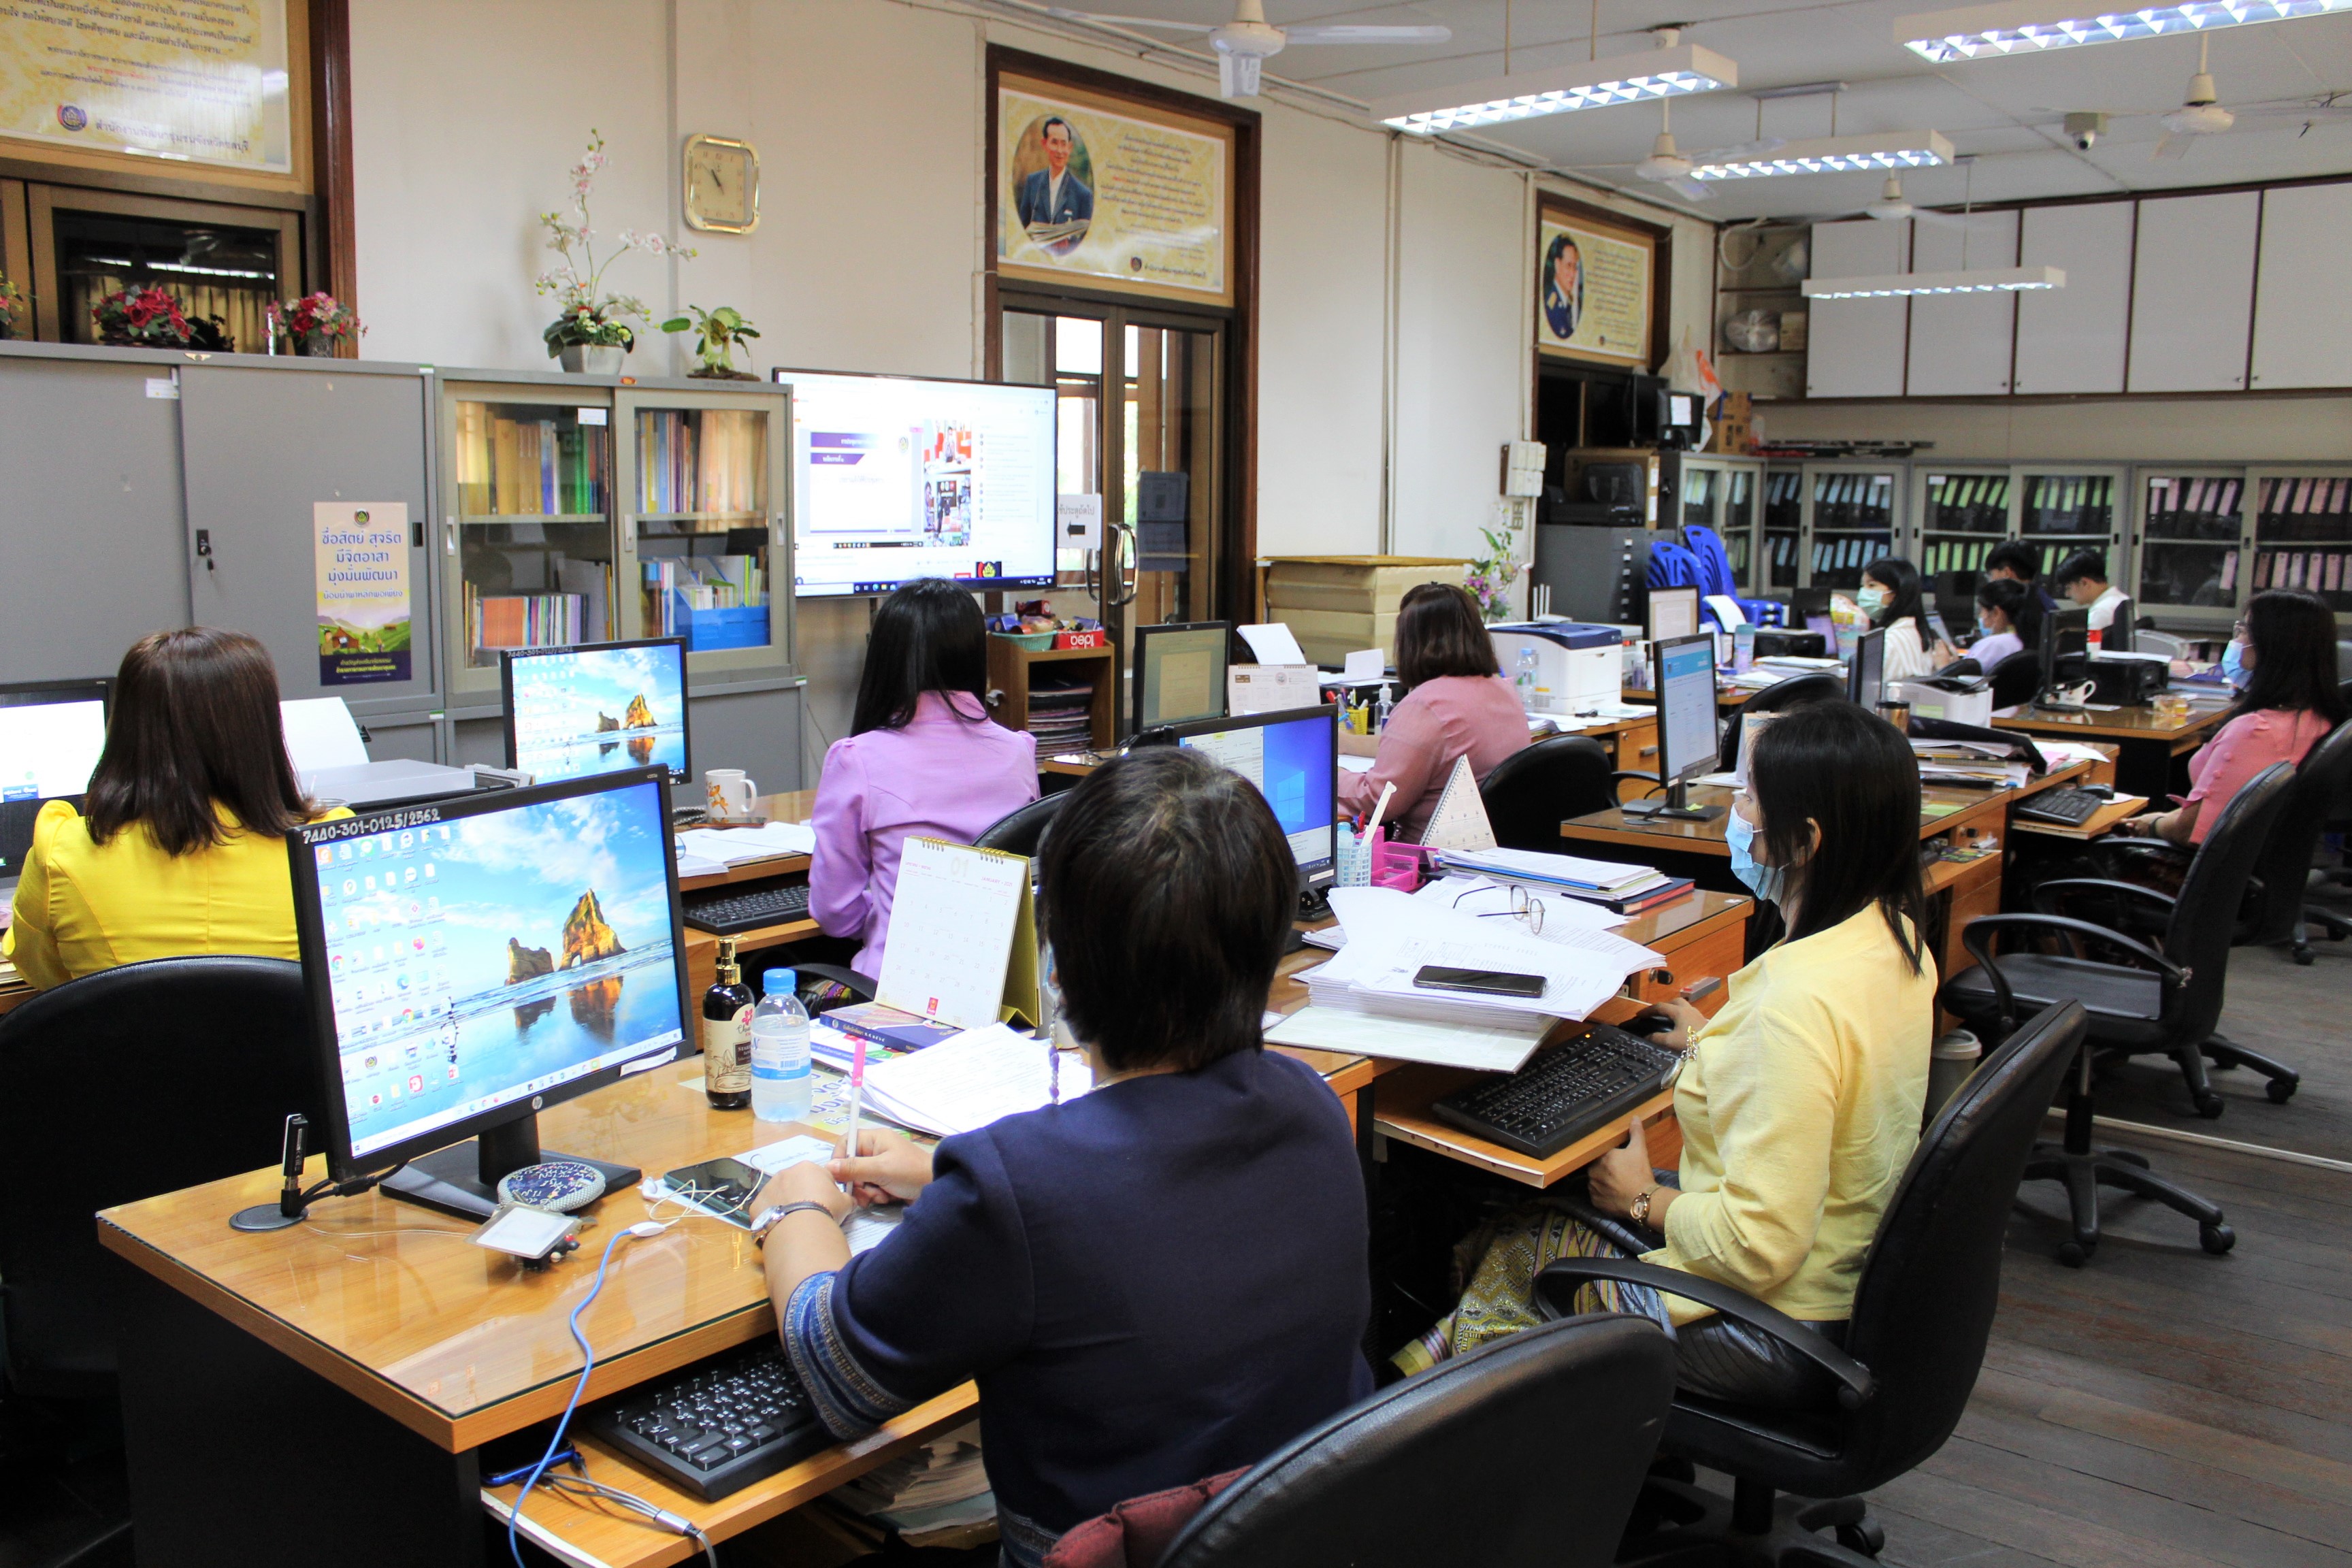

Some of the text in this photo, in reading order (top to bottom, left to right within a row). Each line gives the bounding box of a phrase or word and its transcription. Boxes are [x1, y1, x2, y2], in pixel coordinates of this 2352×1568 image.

[1058, 504, 1094, 519] ช้ประตูถัดไป
[370, 531, 402, 548] สุจริต
[337, 549, 389, 564] มีจิตอาสา
[328, 564, 398, 585] มุ่งมั่นพัฒนา
